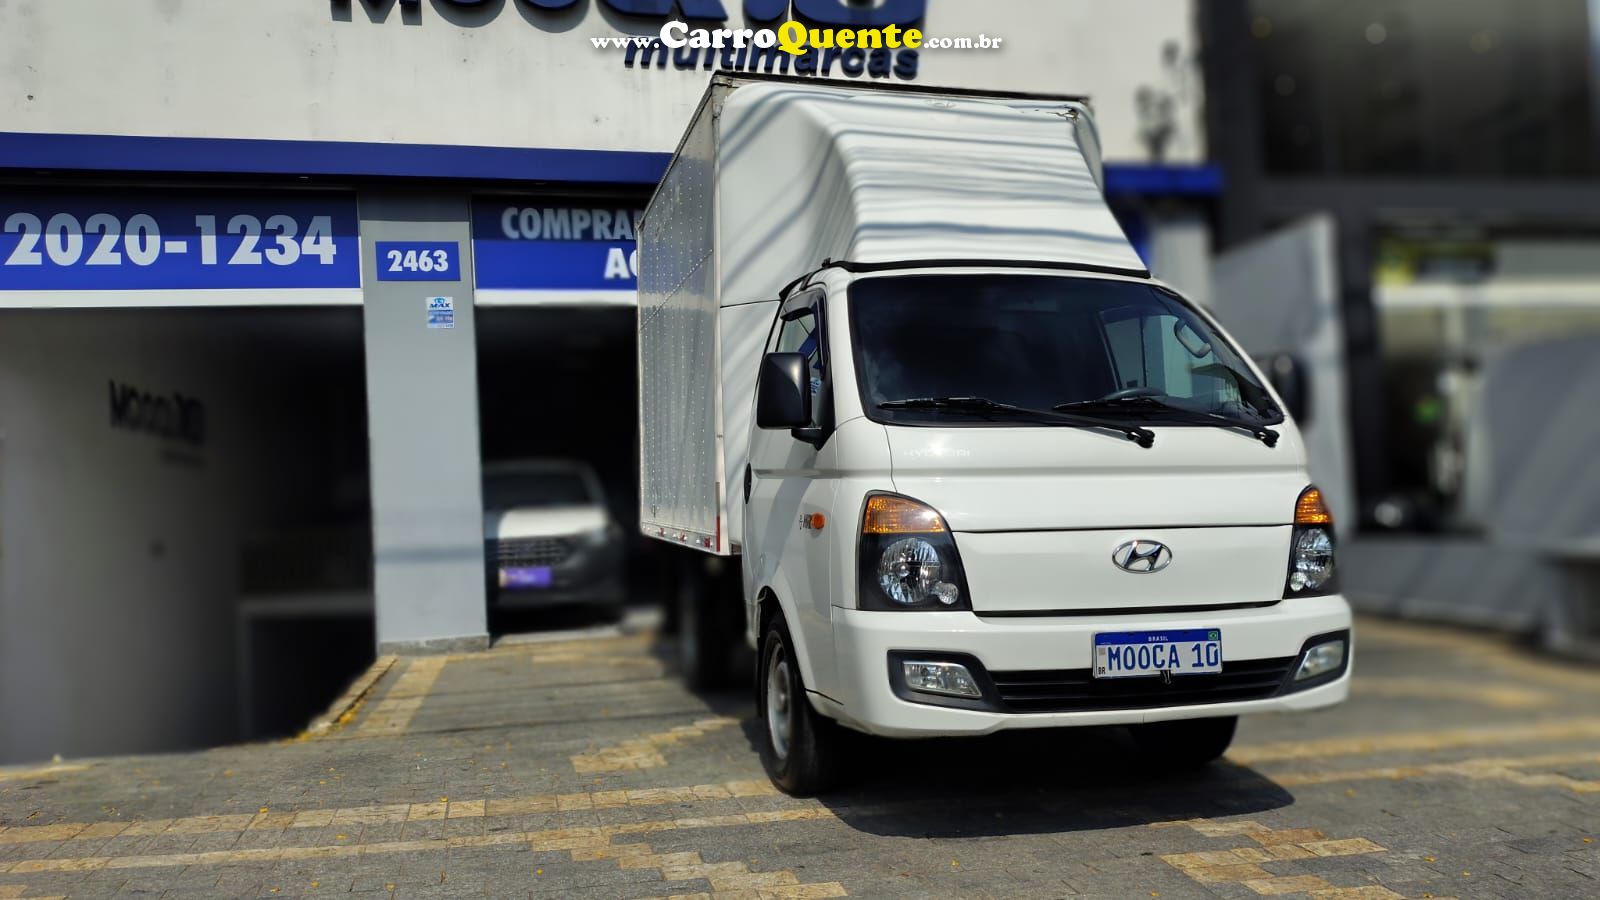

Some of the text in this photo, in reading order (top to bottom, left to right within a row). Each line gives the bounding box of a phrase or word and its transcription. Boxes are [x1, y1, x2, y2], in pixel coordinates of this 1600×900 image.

[501, 207, 642, 240] COMPRA
[3, 212, 337, 266] 2020-1234
[387, 249, 449, 272] 2463
[1107, 644, 1180, 671] MOOCA
